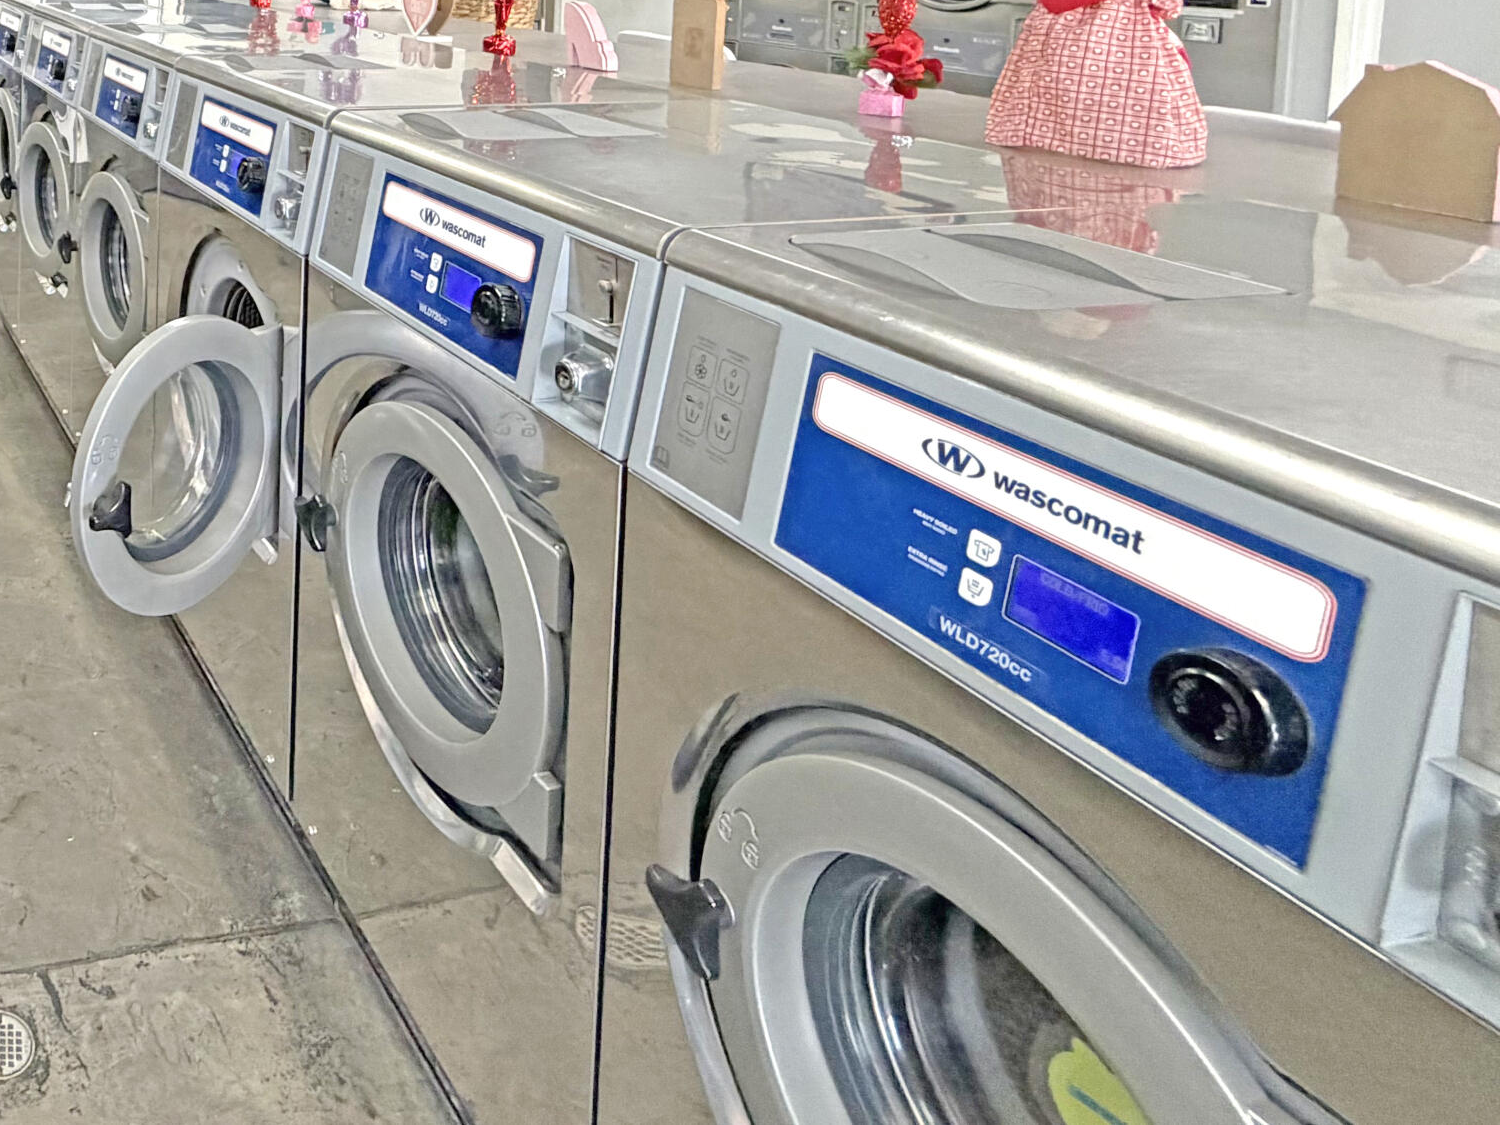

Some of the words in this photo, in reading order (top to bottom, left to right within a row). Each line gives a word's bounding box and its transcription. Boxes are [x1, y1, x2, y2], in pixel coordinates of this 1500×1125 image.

[441, 219, 486, 248] wascomat
[993, 471, 1145, 555] wascomat
[939, 615, 1033, 683] WLD720cc
